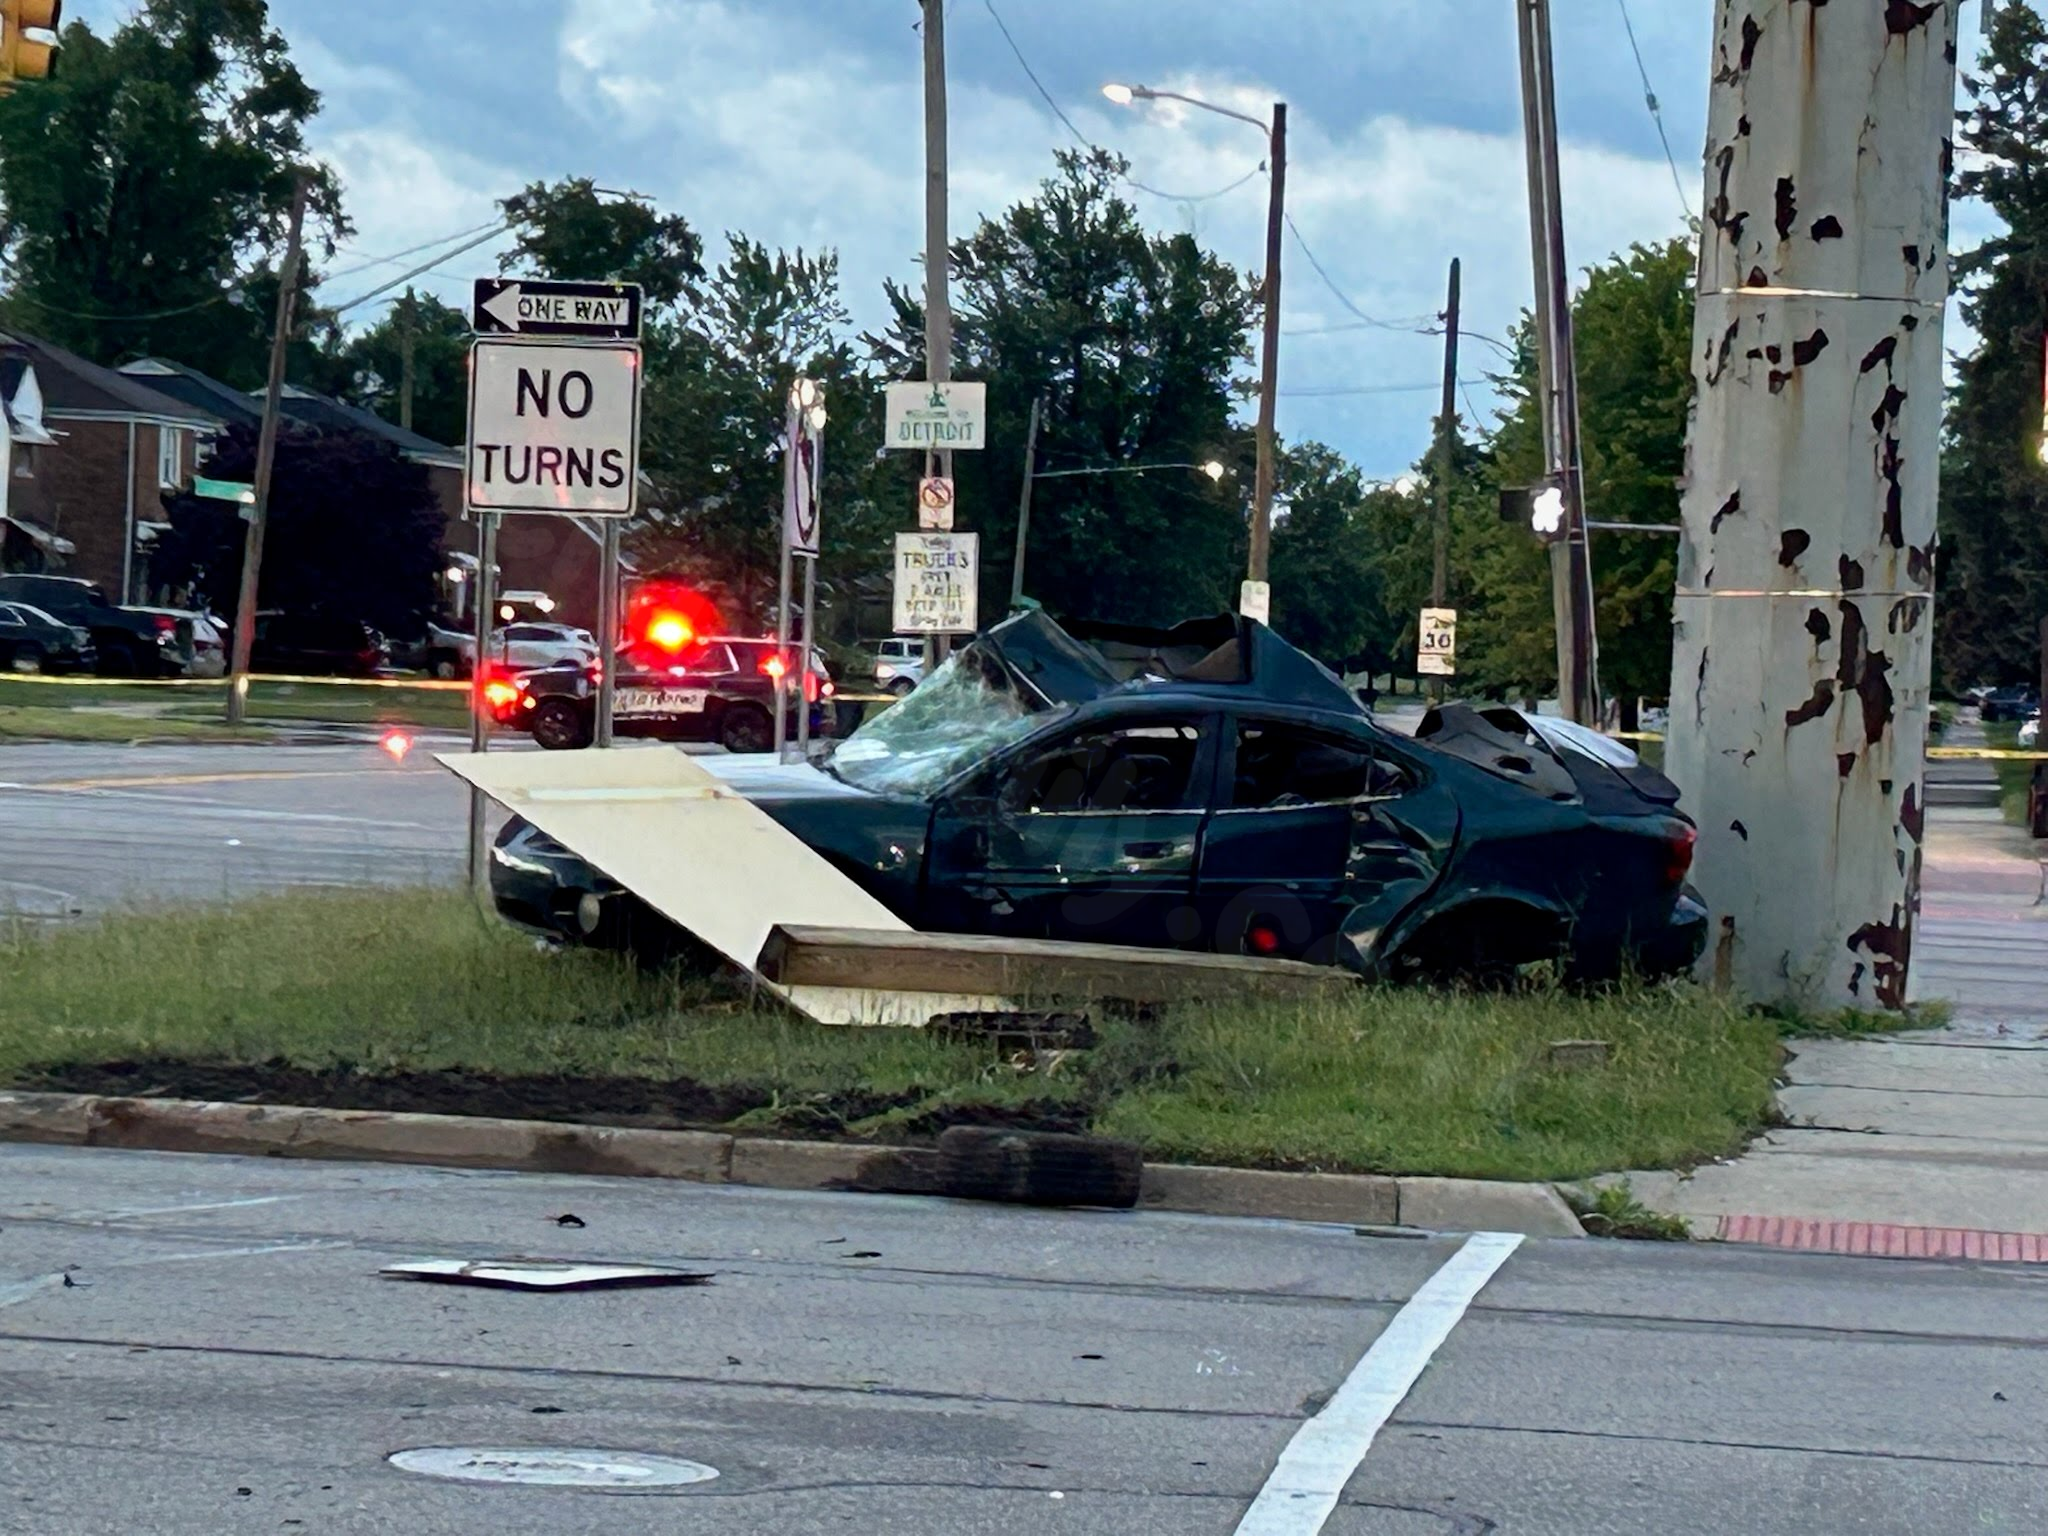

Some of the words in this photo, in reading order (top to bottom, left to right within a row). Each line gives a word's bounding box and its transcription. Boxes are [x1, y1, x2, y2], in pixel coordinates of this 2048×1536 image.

[518, 297, 566, 320] ONE
[575, 300, 621, 322] WAY
[516, 367, 593, 418] NO
[899, 421, 974, 441] DETROIT
[476, 444, 624, 488] TURNS
